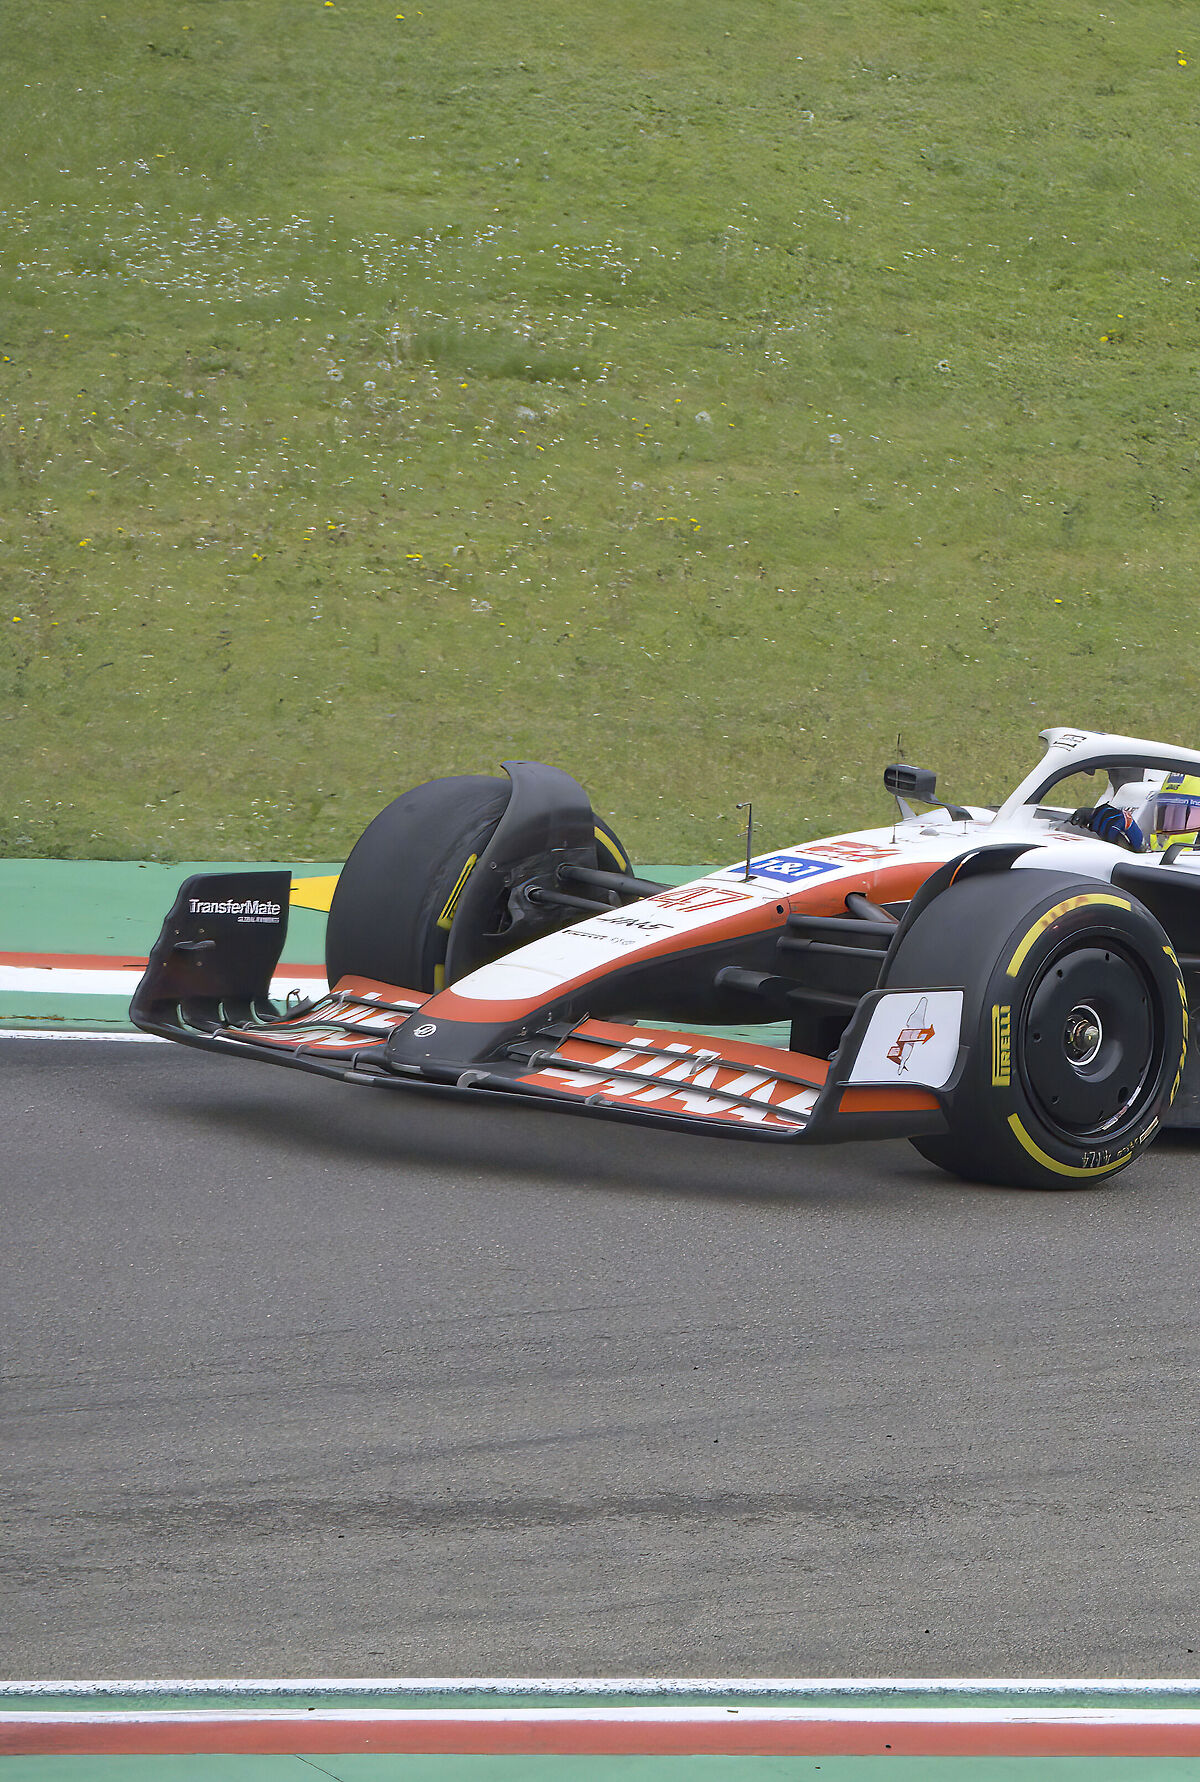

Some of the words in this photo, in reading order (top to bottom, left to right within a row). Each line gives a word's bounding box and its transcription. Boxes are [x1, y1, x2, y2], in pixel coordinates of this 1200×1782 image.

[751, 858, 824, 877] 1&1
[188, 898, 281, 915] TransferMate
[991, 1004, 1011, 1087] PIRELLI
